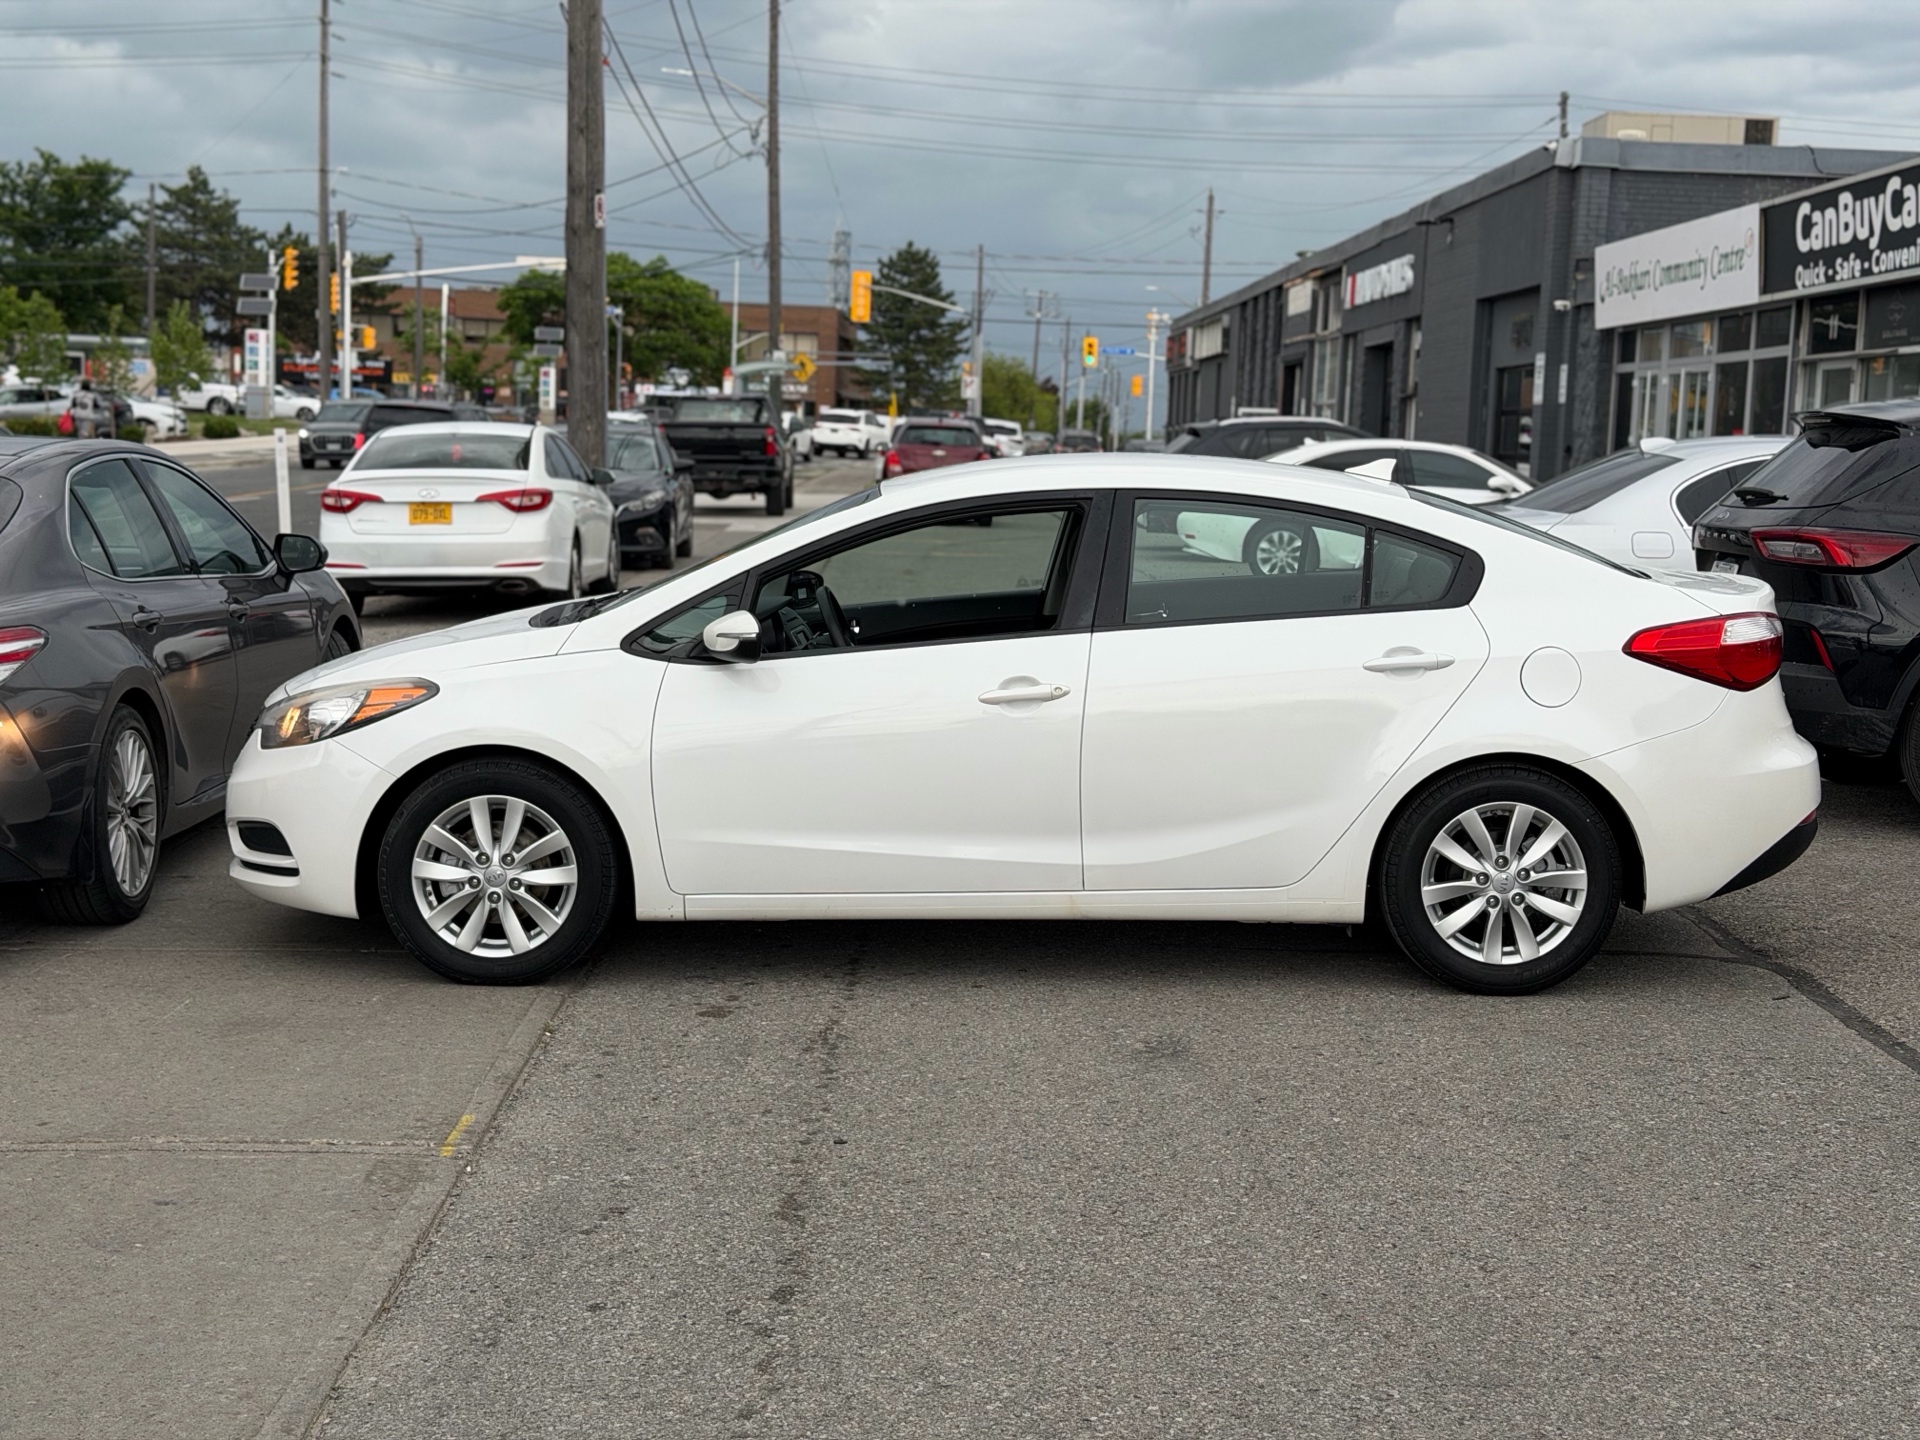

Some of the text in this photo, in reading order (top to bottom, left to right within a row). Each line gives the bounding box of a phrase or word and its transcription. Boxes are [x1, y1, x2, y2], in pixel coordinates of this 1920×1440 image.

[1795, 175, 1920, 254] CanBuyCa
[1653, 248, 1708, 292] Community
[1710, 245, 1746, 280] Centre
[1795, 259, 1826, 290] Quick
[1835, 252, 1861, 281] Safe
[485, 873, 504, 884] KIA
